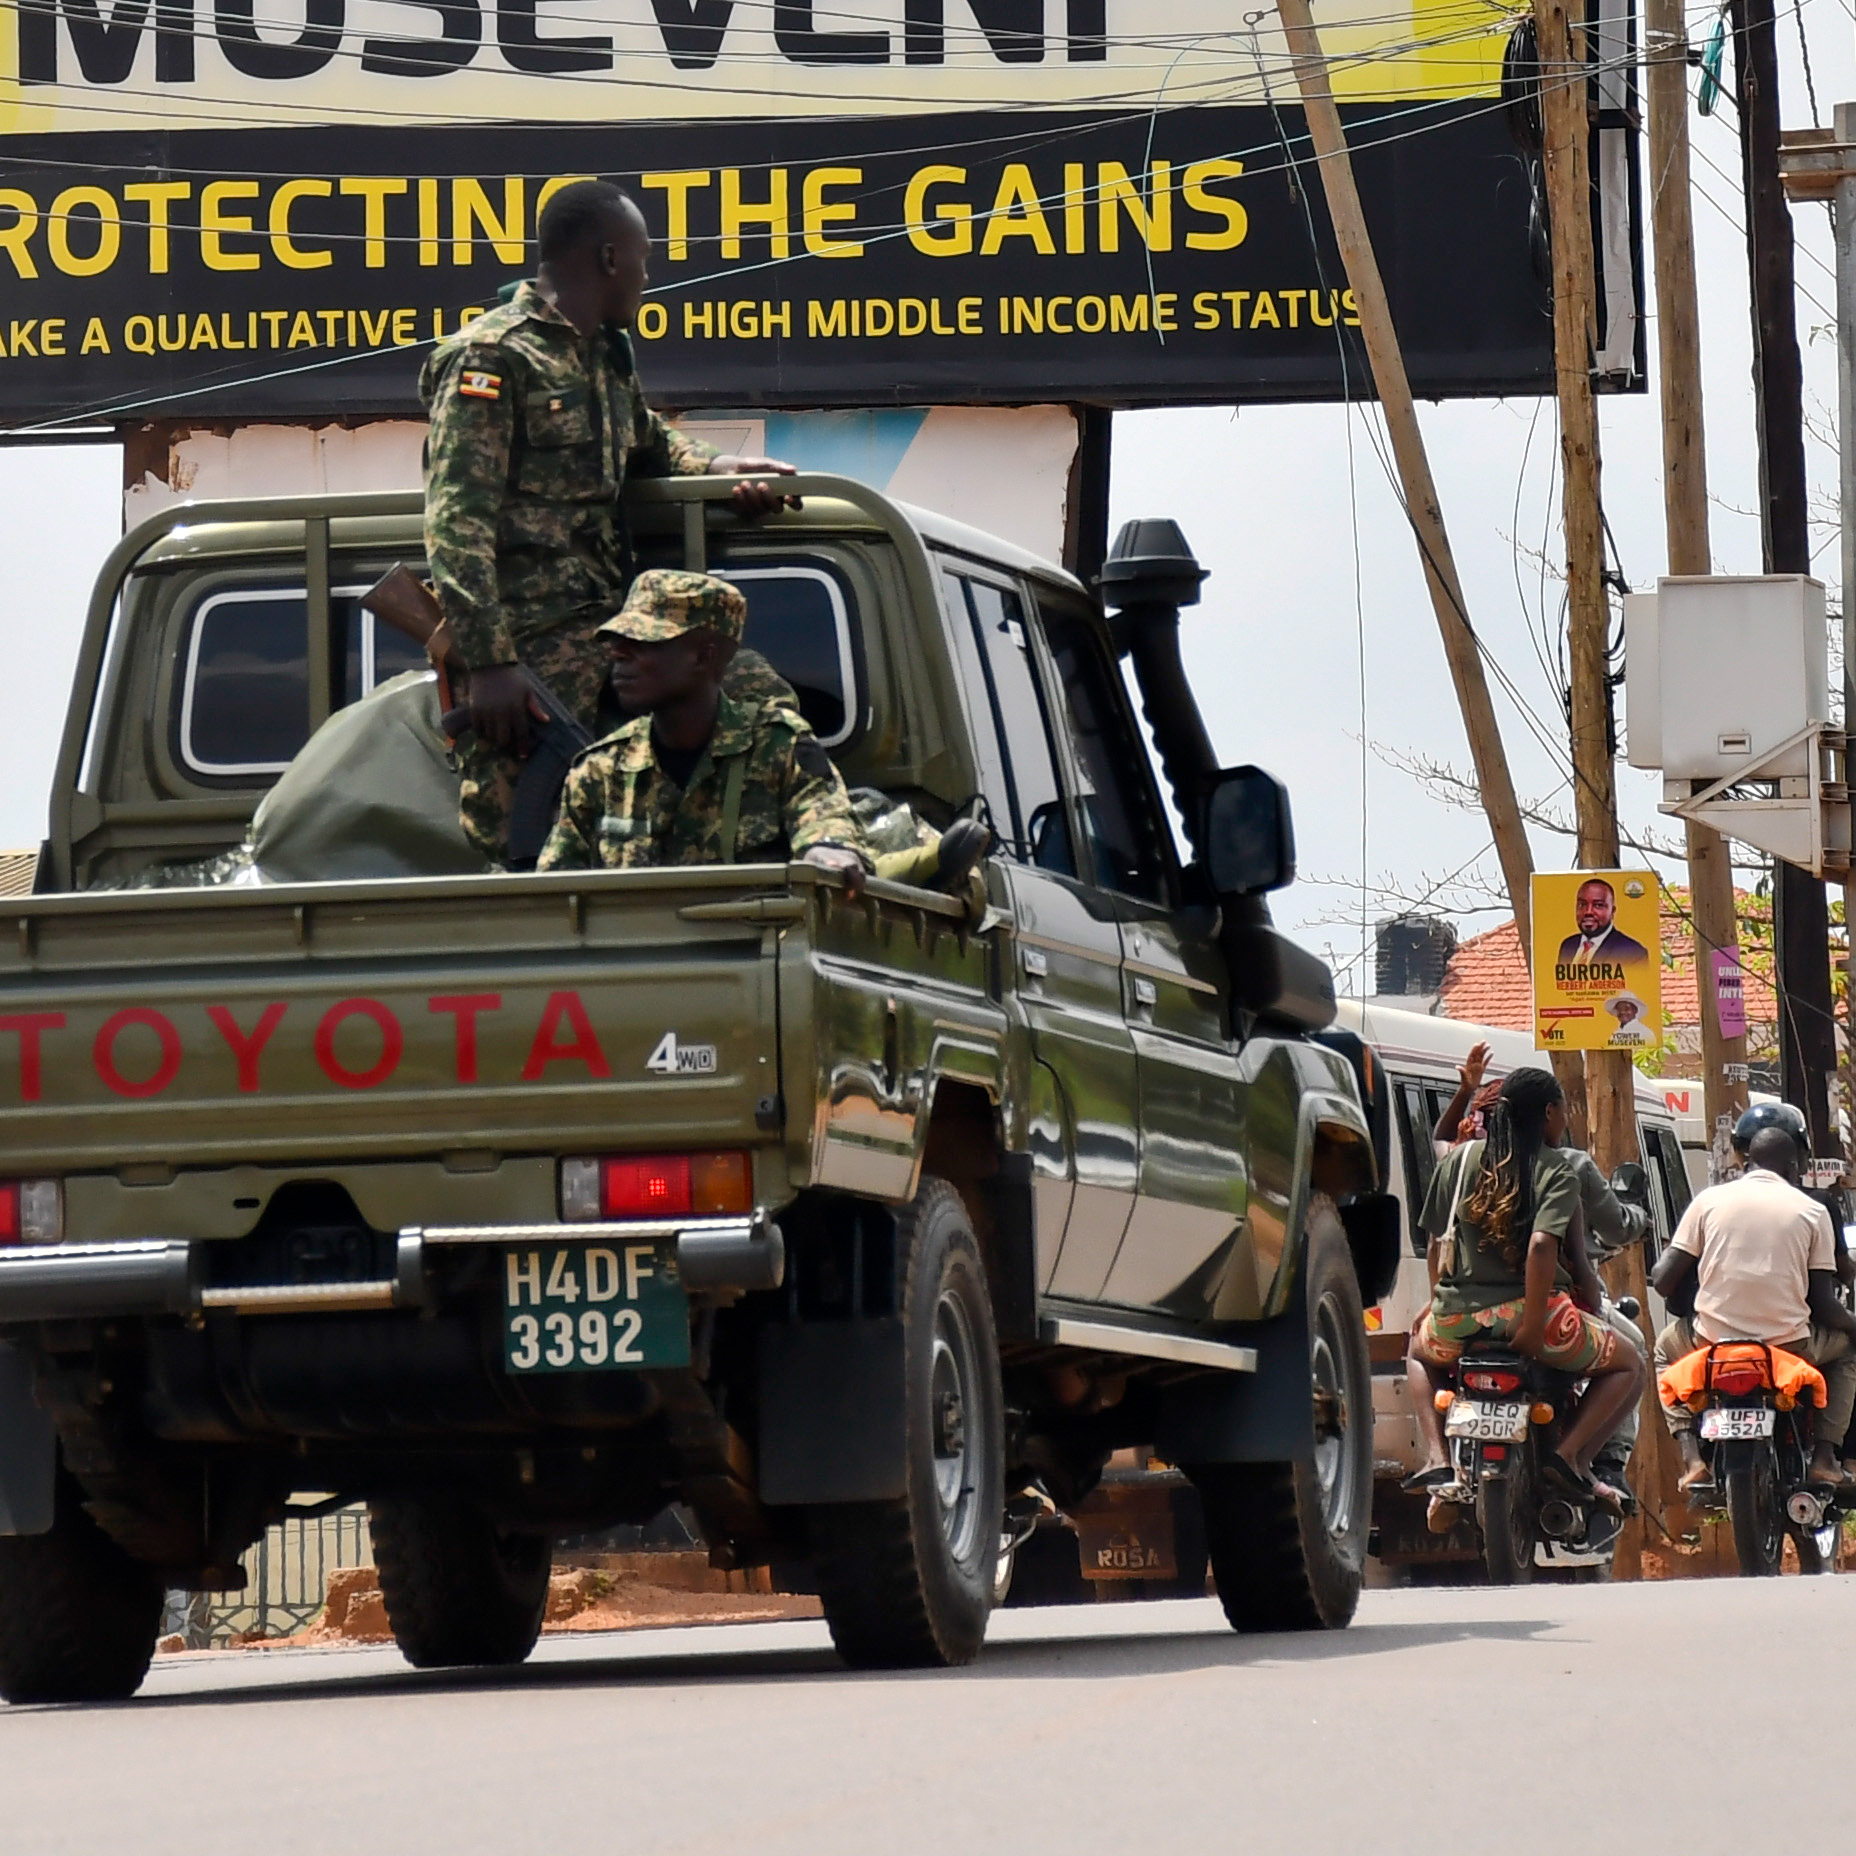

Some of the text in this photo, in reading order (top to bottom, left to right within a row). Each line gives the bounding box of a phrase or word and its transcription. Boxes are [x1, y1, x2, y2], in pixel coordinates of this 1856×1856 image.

[641, 167, 865, 261] THE
[903, 158, 1249, 257] GAINS
[79, 317, 111, 355] A
[122, 308, 417, 357] QUALITATIVE
[682, 300, 792, 339] HIGH
[807, 296, 984, 338] MIDDLE
[999, 293, 1180, 334] INCOME
[1555, 963, 1625, 981] BURORA
[1588, 979, 1626, 990] ANDERSON
[645, 1031, 717, 1074] 4WD
[1607, 1038, 1646, 1046] MUSEVENI
[507, 1246, 655, 1307] H4DF
[510, 1308, 644, 1369] 3392
[1480, 1401, 1520, 1419] UEQ
[1730, 1410, 1766, 1422] UFD
